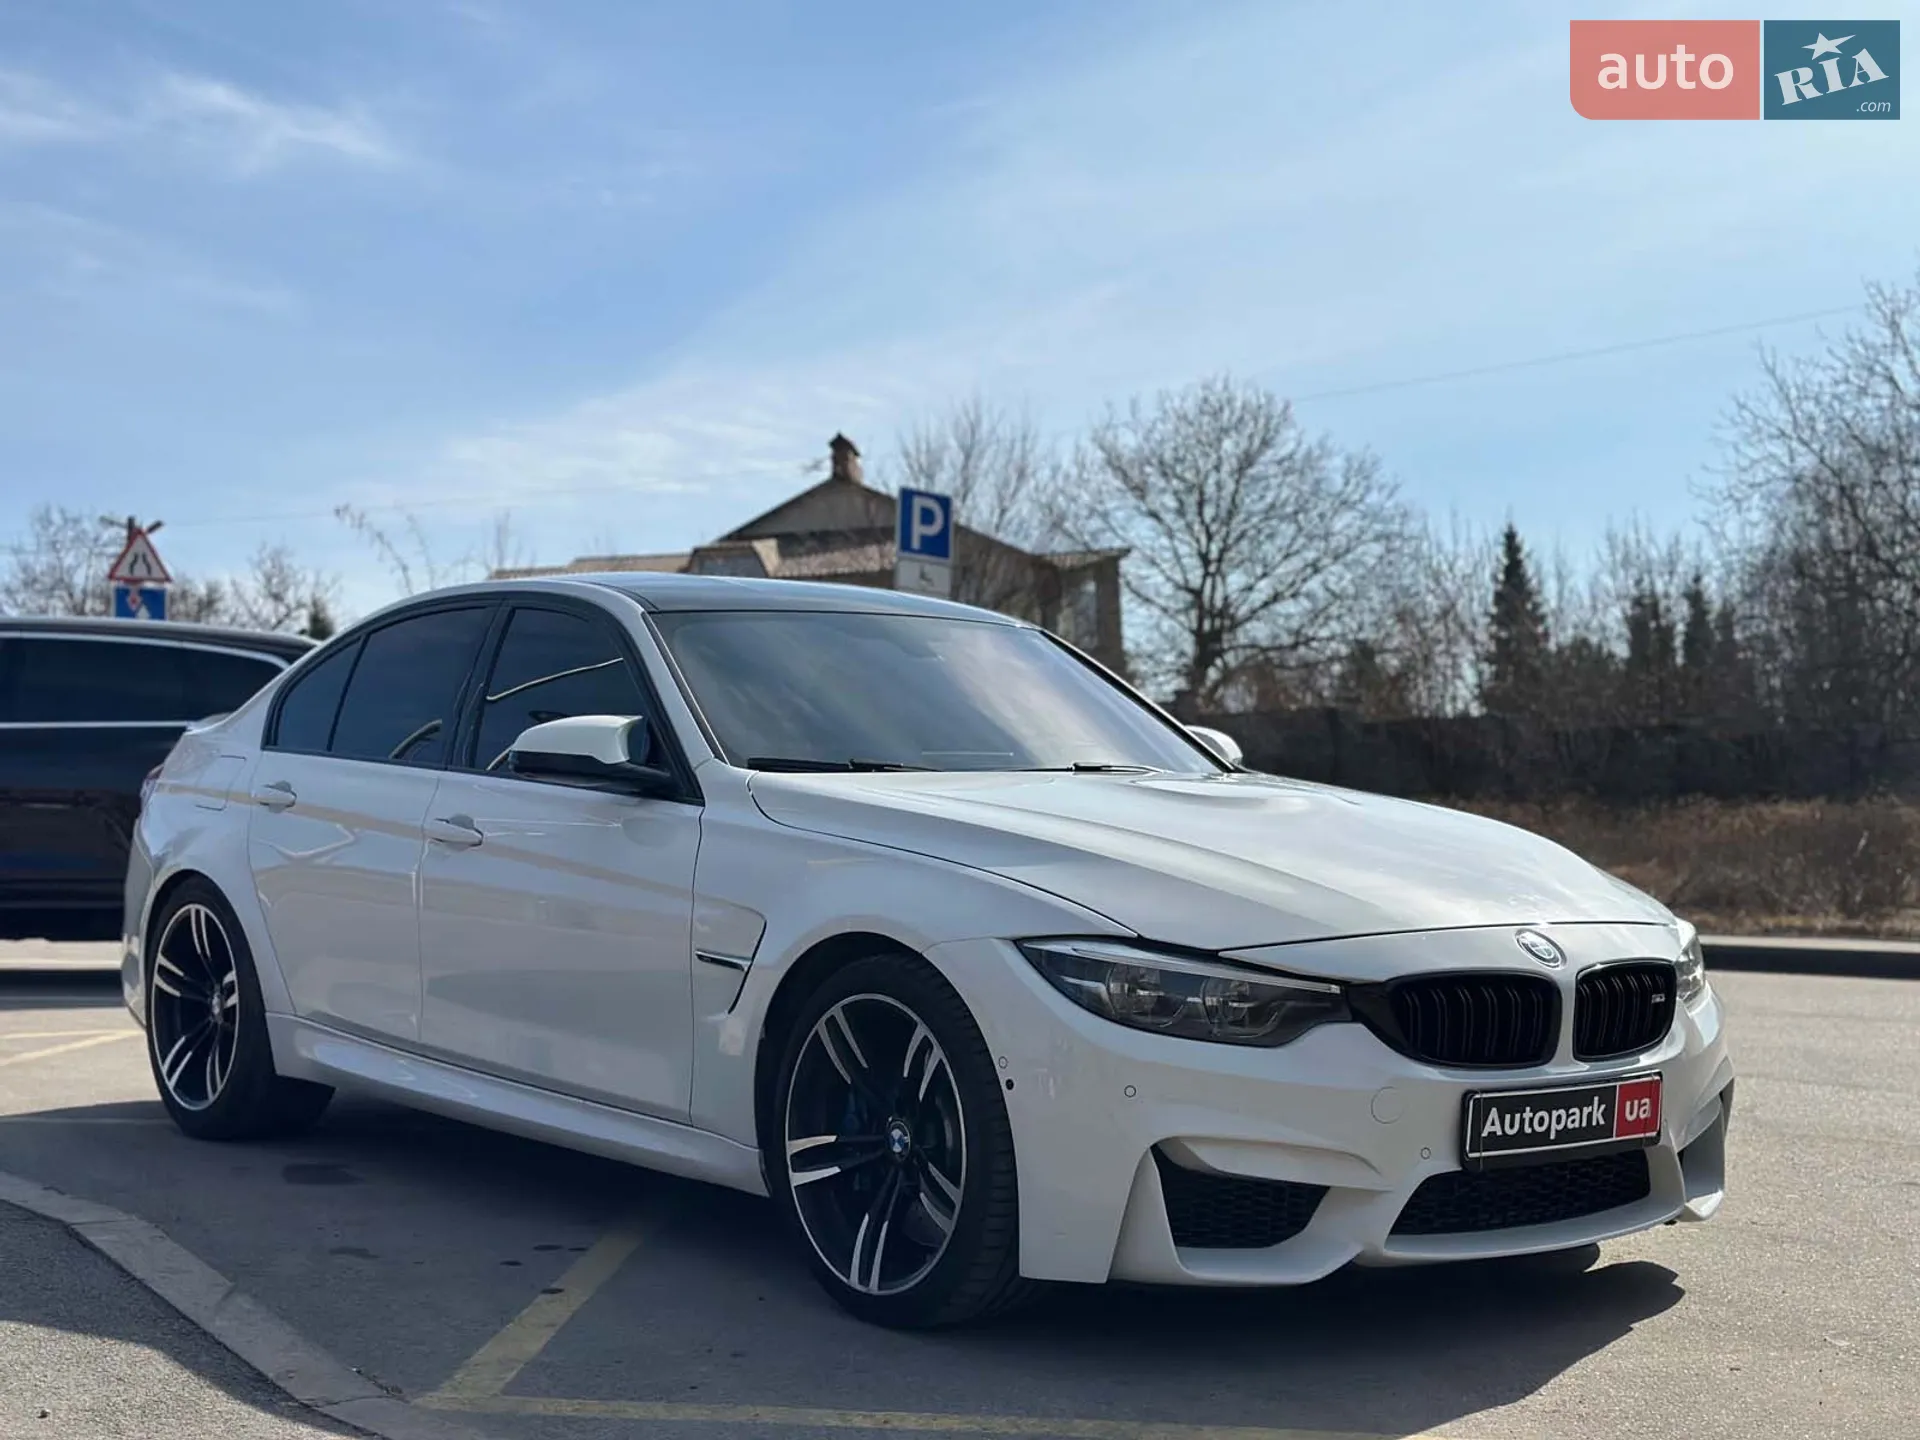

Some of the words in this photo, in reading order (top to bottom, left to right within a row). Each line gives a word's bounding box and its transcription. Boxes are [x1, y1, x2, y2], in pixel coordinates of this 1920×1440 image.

[911, 494, 945, 550] P
[1481, 1096, 1607, 1140] Autopark
[1624, 1097, 1650, 1121] ua
